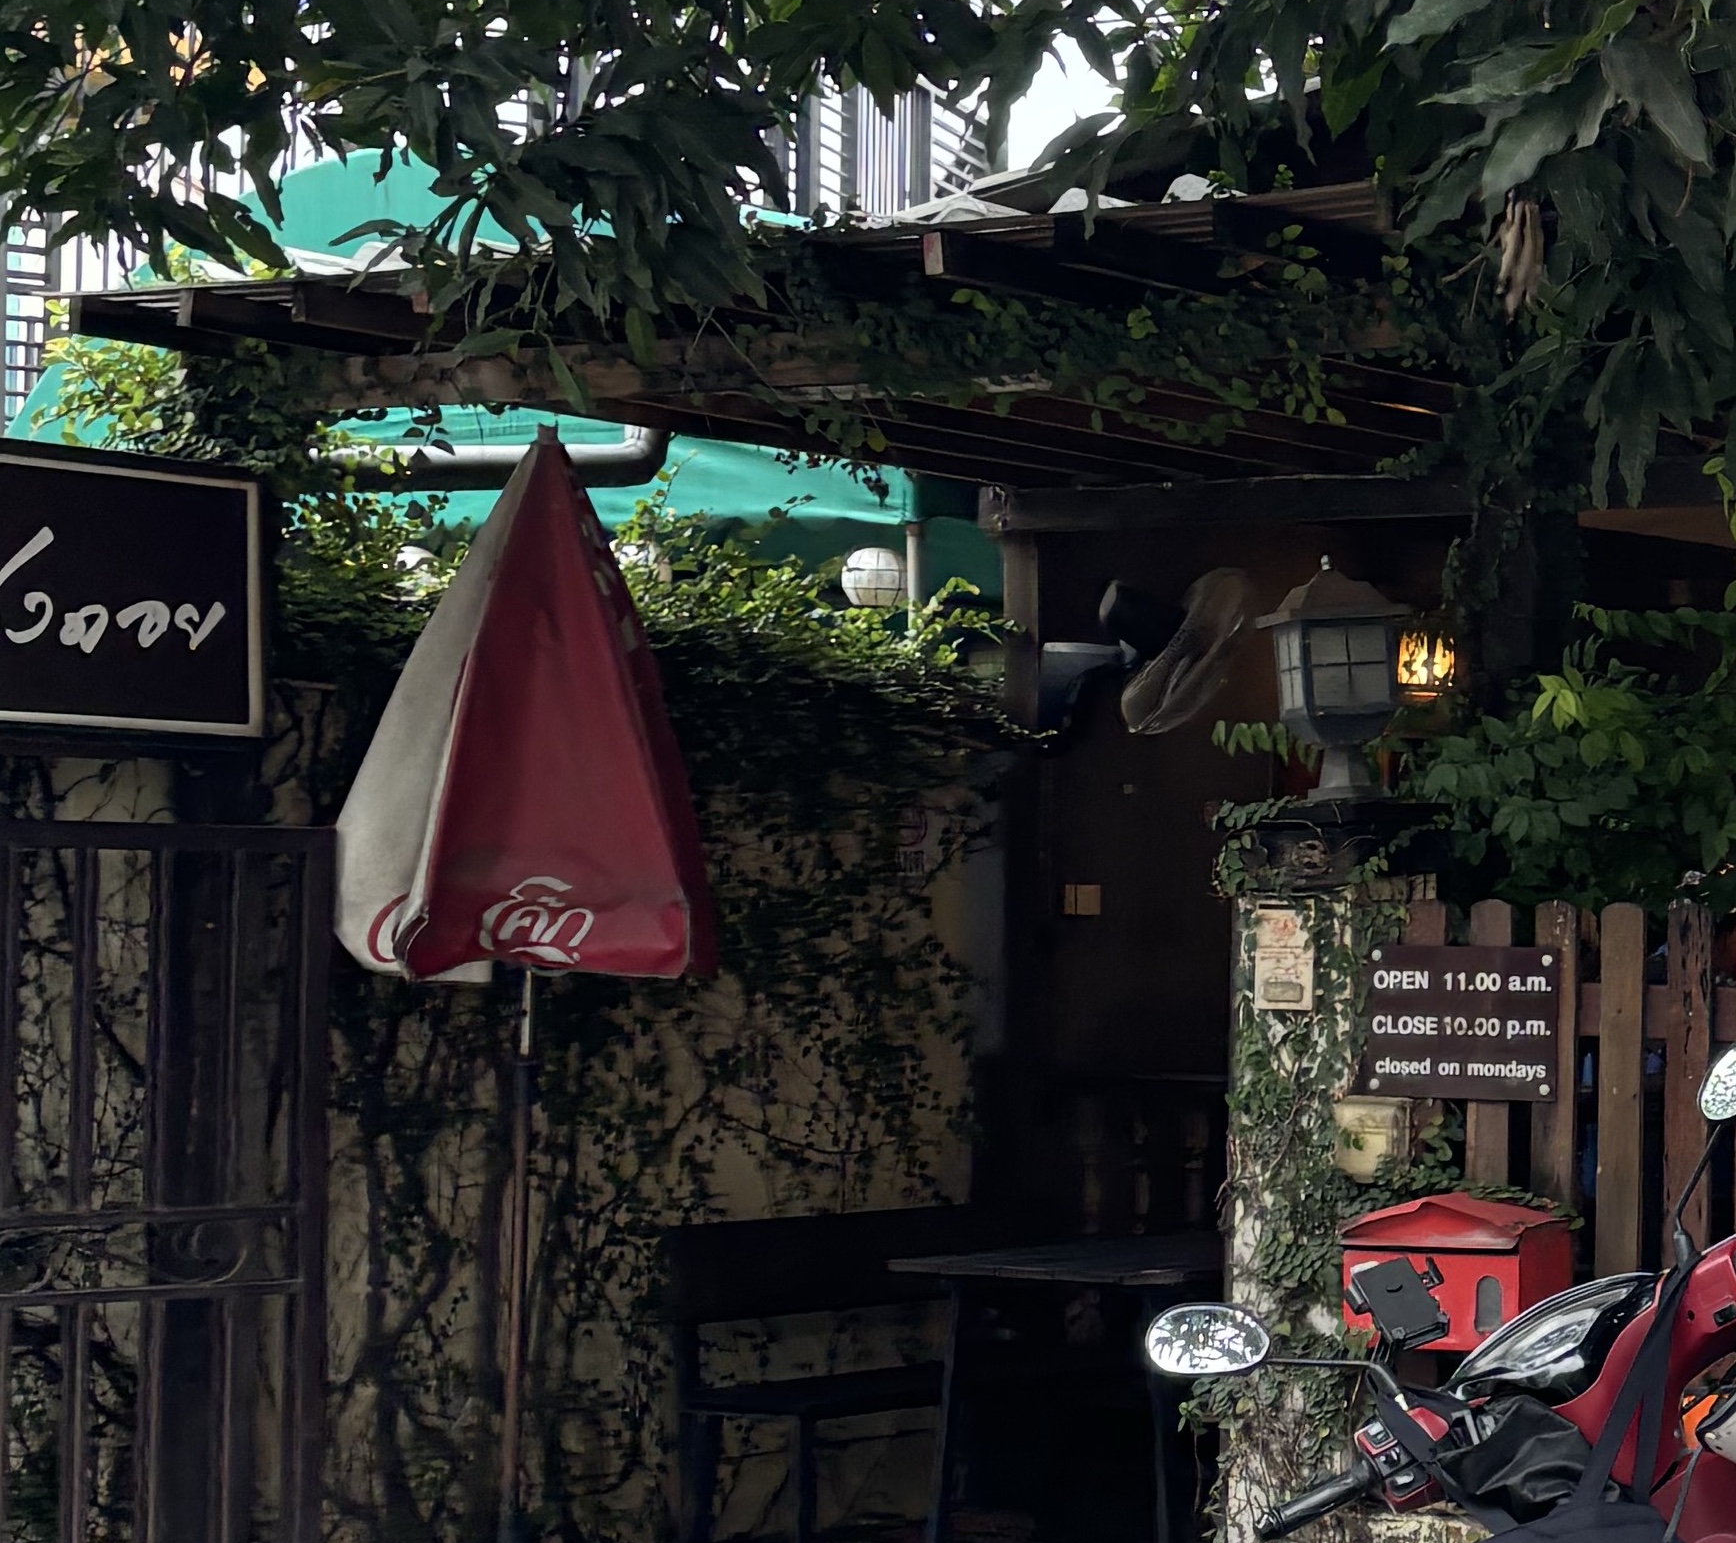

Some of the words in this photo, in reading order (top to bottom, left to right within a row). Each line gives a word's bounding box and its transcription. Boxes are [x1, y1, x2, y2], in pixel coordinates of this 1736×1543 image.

[1373, 970, 1430, 990] OPEN
[1443, 972, 1501, 992] 11.00
[1508, 975, 1552, 992] a.m.
[1372, 1015, 1438, 1036] CLOSE
[1443, 1016, 1501, 1037] 10.00
[1506, 1019, 1551, 1040] p.m.
[1375, 1057, 1431, 1076] closed
[1438, 1062, 1460, 1076] on
[1467, 1060, 1546, 1081] mondays
